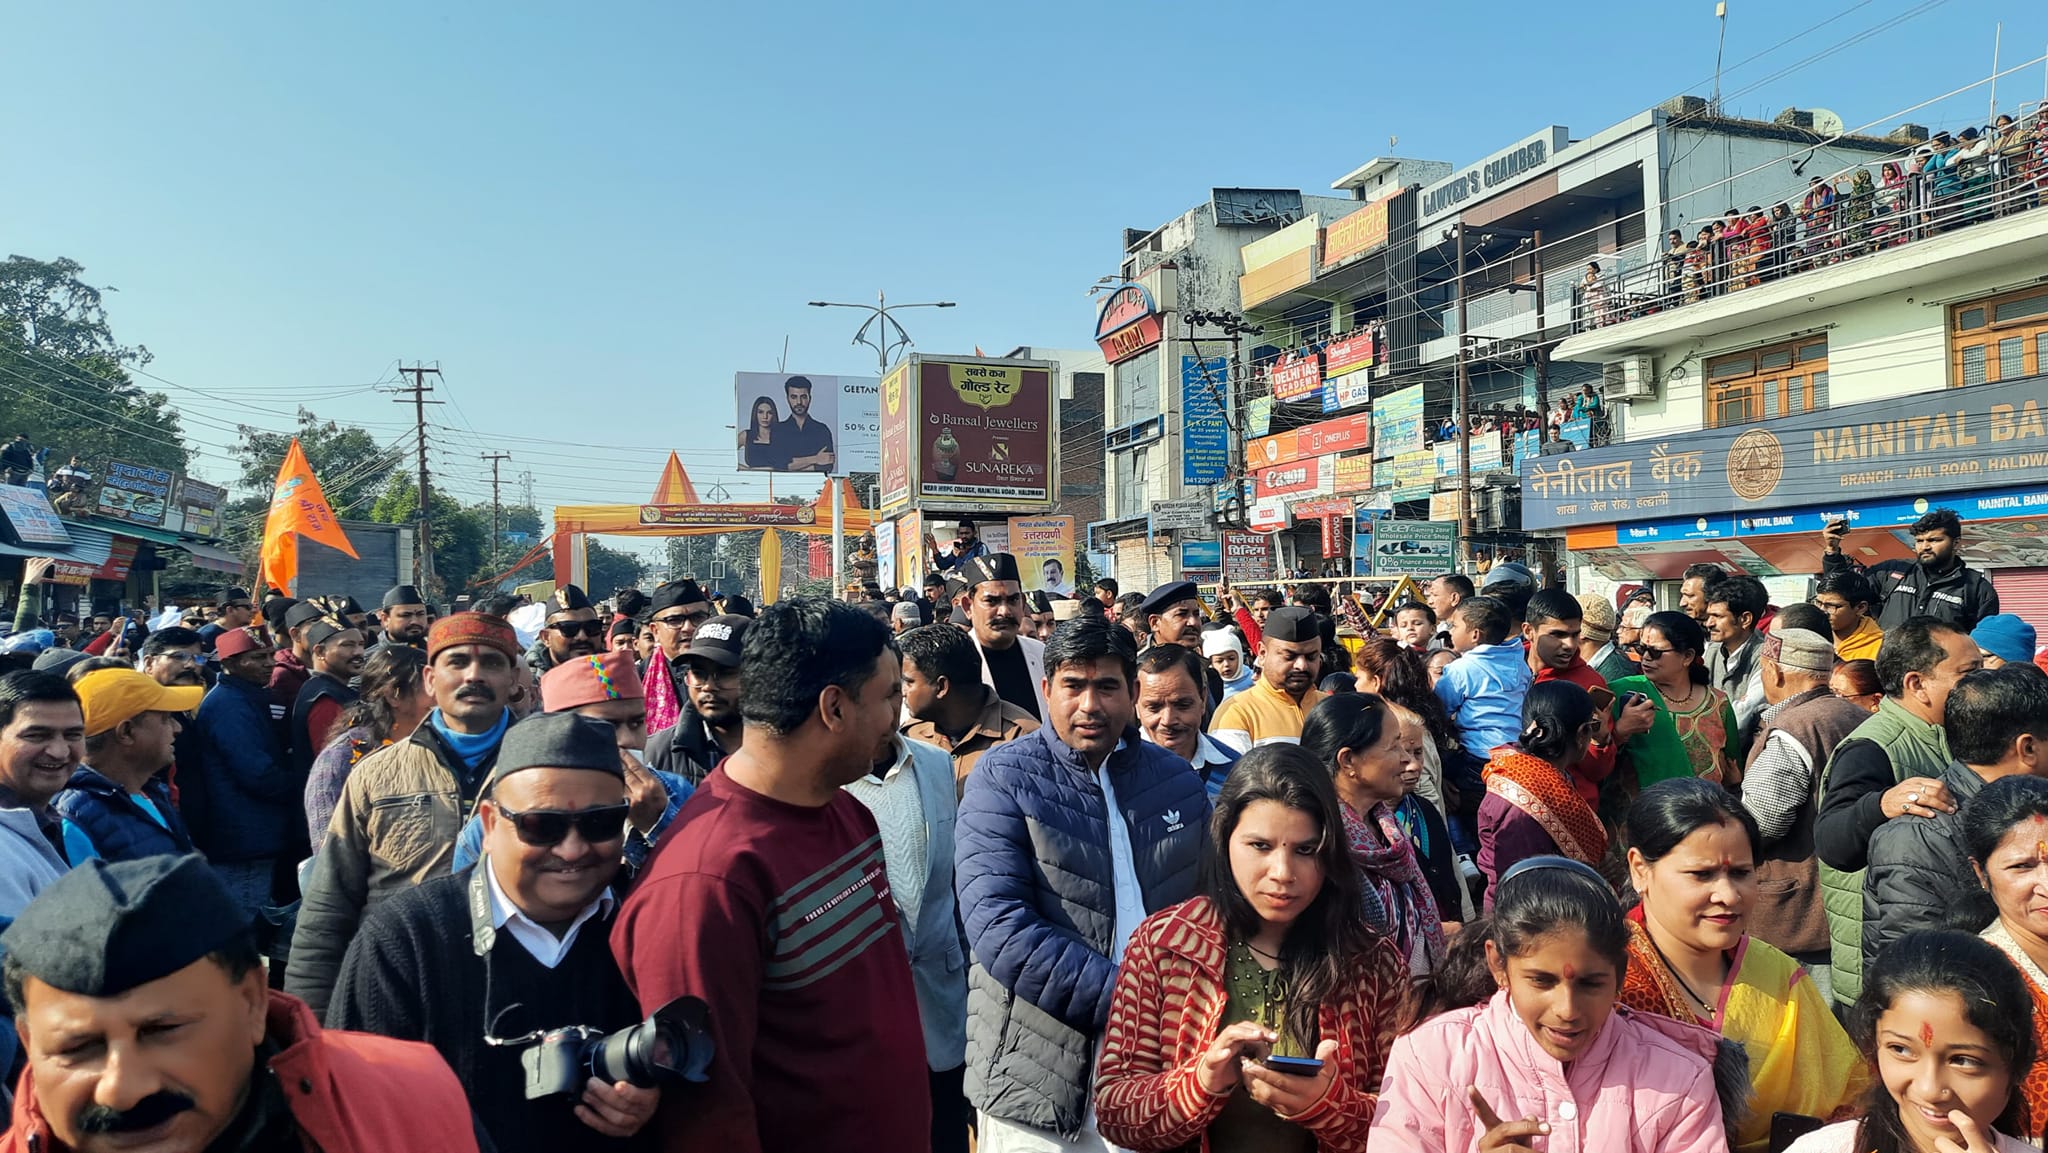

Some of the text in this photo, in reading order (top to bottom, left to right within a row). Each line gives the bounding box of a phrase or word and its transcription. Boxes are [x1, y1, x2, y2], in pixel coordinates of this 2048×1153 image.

[1423, 139, 1547, 217] LAWYER'S CHAMBER
[965, 367, 1006, 378] सबसे कम
[1275, 366, 1301, 385] DELHI
[1302, 361, 1318, 376] IAS
[960, 378, 1011, 394] गोल्ड रेट
[1276, 375, 1318, 394] ACADEMY
[1340, 386, 1367, 402] HP GAS
[844, 423, 865, 431] 50%
[942, 413, 1038, 430] Bansal Jewellers
[1324, 430, 1351, 444] ONEPLUS
[1812, 398, 2048, 465] NAINITAL BA
[965, 461, 1034, 475] SUNAREKA
[1529, 442, 1705, 498] नैनीताल बैंक
[1840, 468, 1894, 487] BRANCH
[1905, 465, 1935, 480] JAIL
[1940, 460, 1983, 475] ROAD,
[1265, 467, 1307, 489] Canon
[1556, 504, 1577, 516] शाखा
[1589, 499, 1607, 513] जेल
[1611, 497, 1631, 510] रोड,
[1977, 497, 2022, 510] NAINITAL
[1379, 524, 1413, 533] acer
[1774, 515, 1794, 526] BANK
[1022, 527, 1061, 540] उत्तरायणी
[1228, 533, 1265, 544] फ्लेक्स
[1333, 516, 1341, 554] Lenovo
[1379, 557, 1399, 567] 0%
